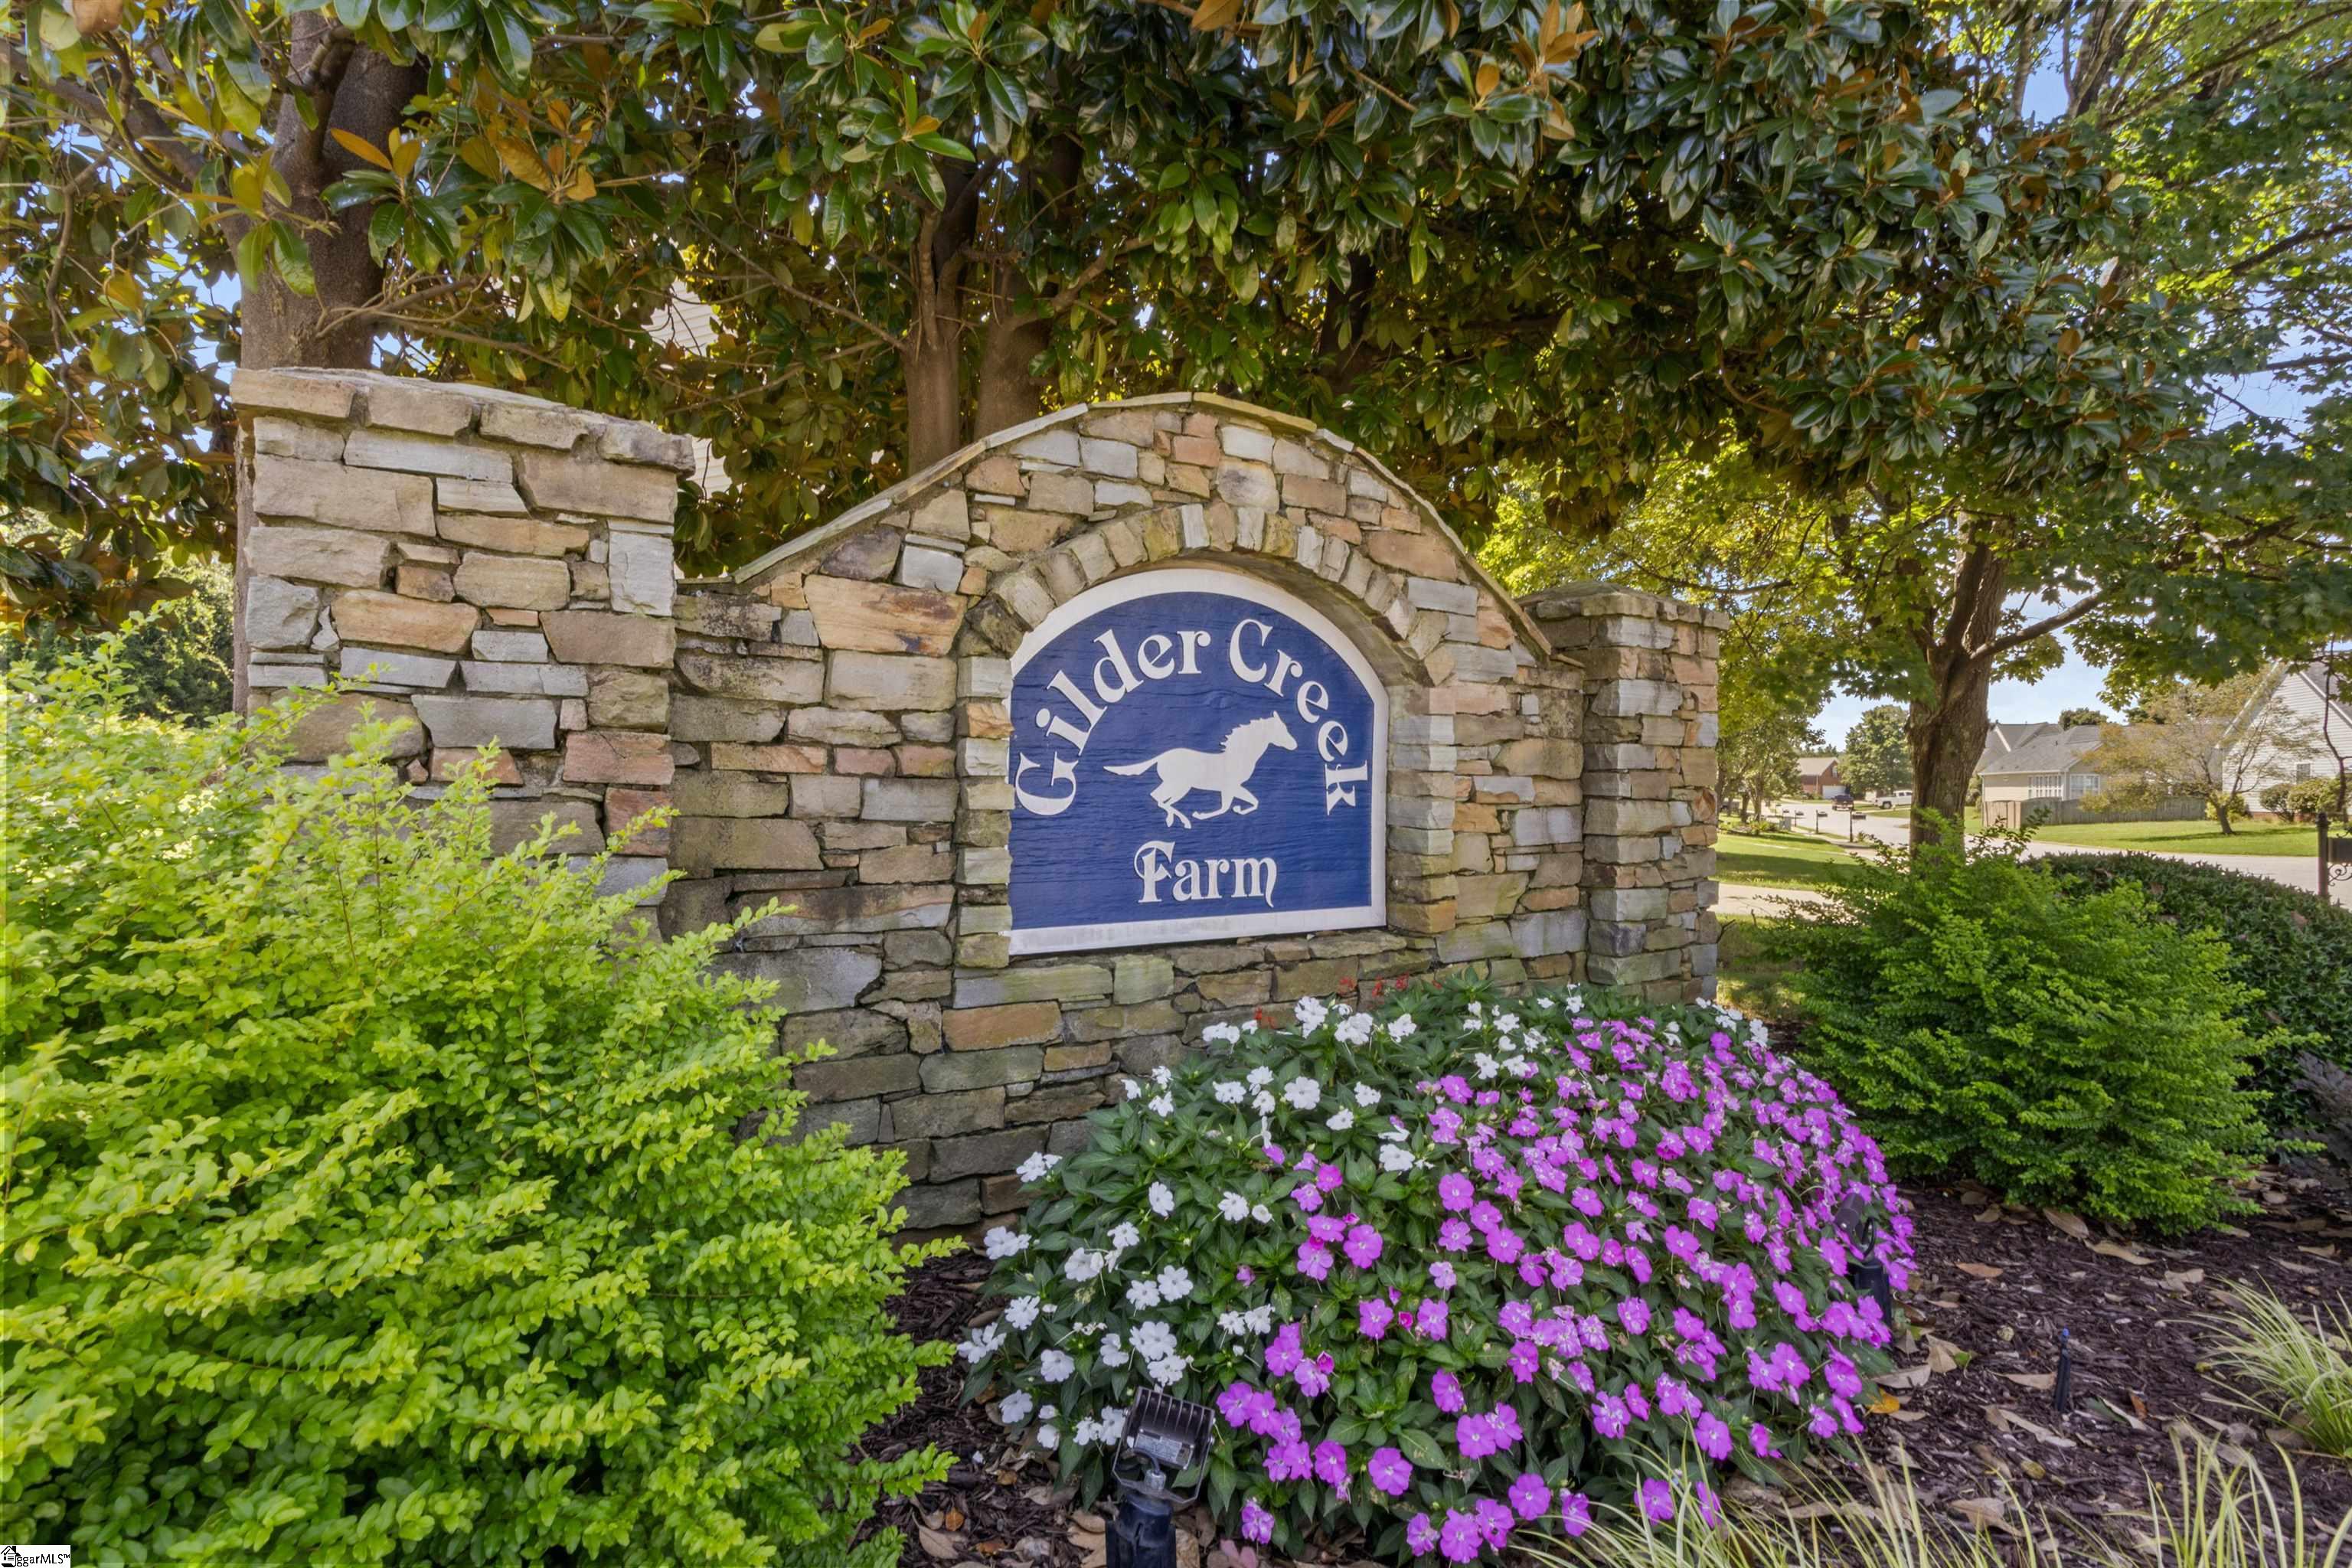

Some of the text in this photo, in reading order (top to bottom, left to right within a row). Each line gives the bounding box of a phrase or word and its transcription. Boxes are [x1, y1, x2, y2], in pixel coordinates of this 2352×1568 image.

[1014, 619, 1368, 816] Gilder Creek
[1134, 841, 1277, 908] Farm
